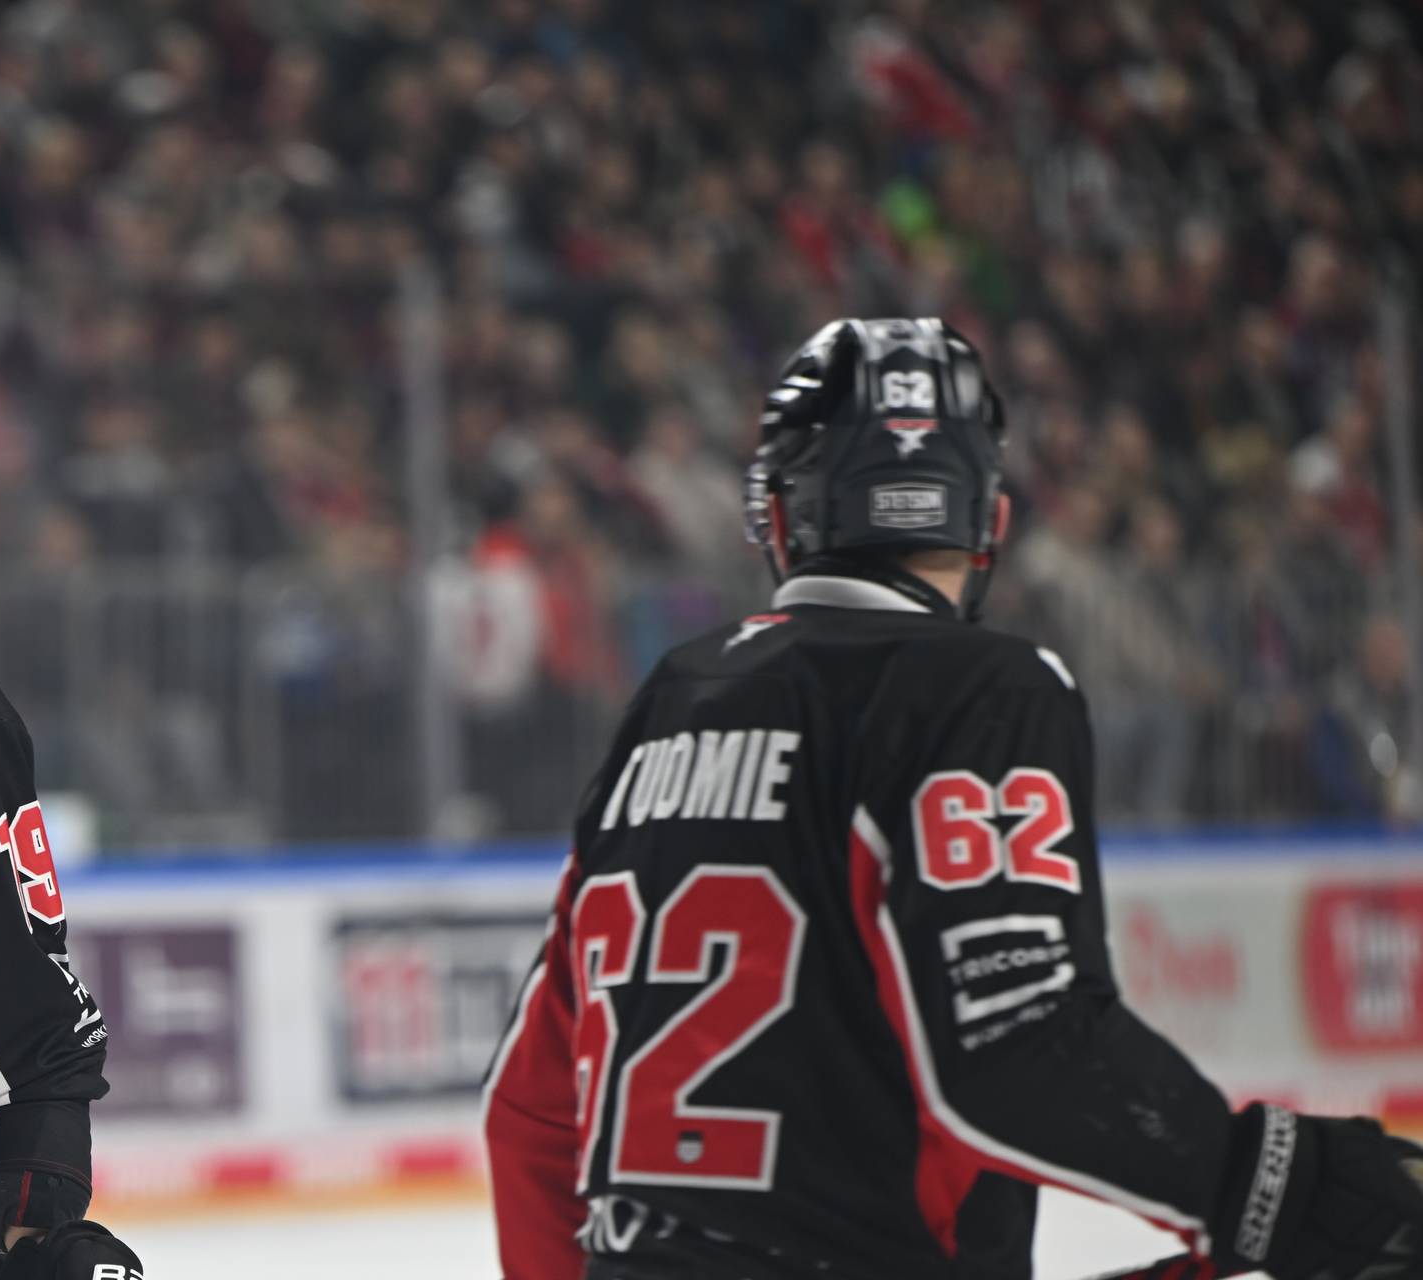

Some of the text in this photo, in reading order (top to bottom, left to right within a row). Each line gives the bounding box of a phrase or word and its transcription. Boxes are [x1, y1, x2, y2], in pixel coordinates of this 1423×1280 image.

[882, 370, 936, 409] 62
[911, 766, 1082, 895] 62
[571, 864, 808, 1194] 62
